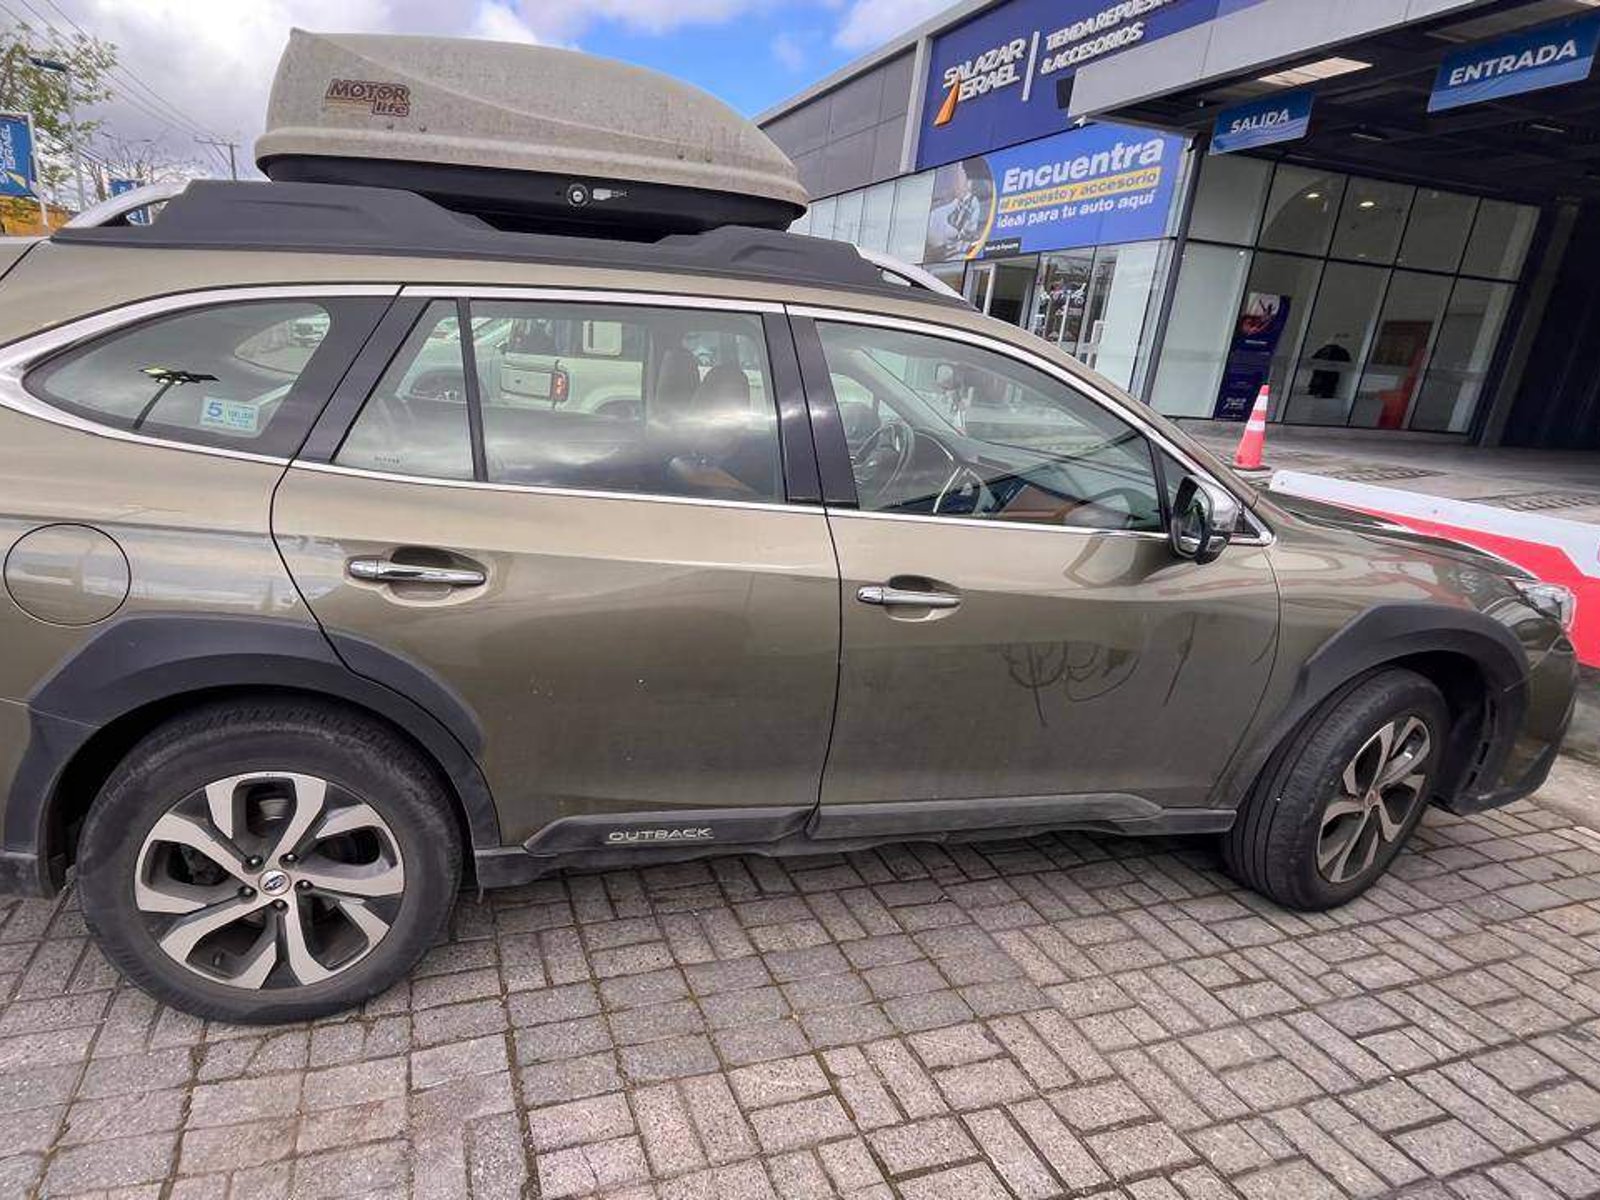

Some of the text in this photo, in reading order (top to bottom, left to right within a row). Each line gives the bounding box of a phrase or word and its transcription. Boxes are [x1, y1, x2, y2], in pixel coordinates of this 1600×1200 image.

[1449, 39, 1578, 86] ENTRADA
[327, 80, 407, 102] MOTOR
[1231, 108, 1289, 134] SALIDA
[1002, 138, 1165, 193] Encuentra
[1080, 171, 1157, 196] accesorio
[1028, 207, 1060, 226] para
[1062, 203, 1077, 218] tu
[1080, 197, 1114, 214] auto
[1118, 189, 1156, 212] aquí
[207, 401, 223, 418] 5
[608, 828, 715, 841] OUTBACK
